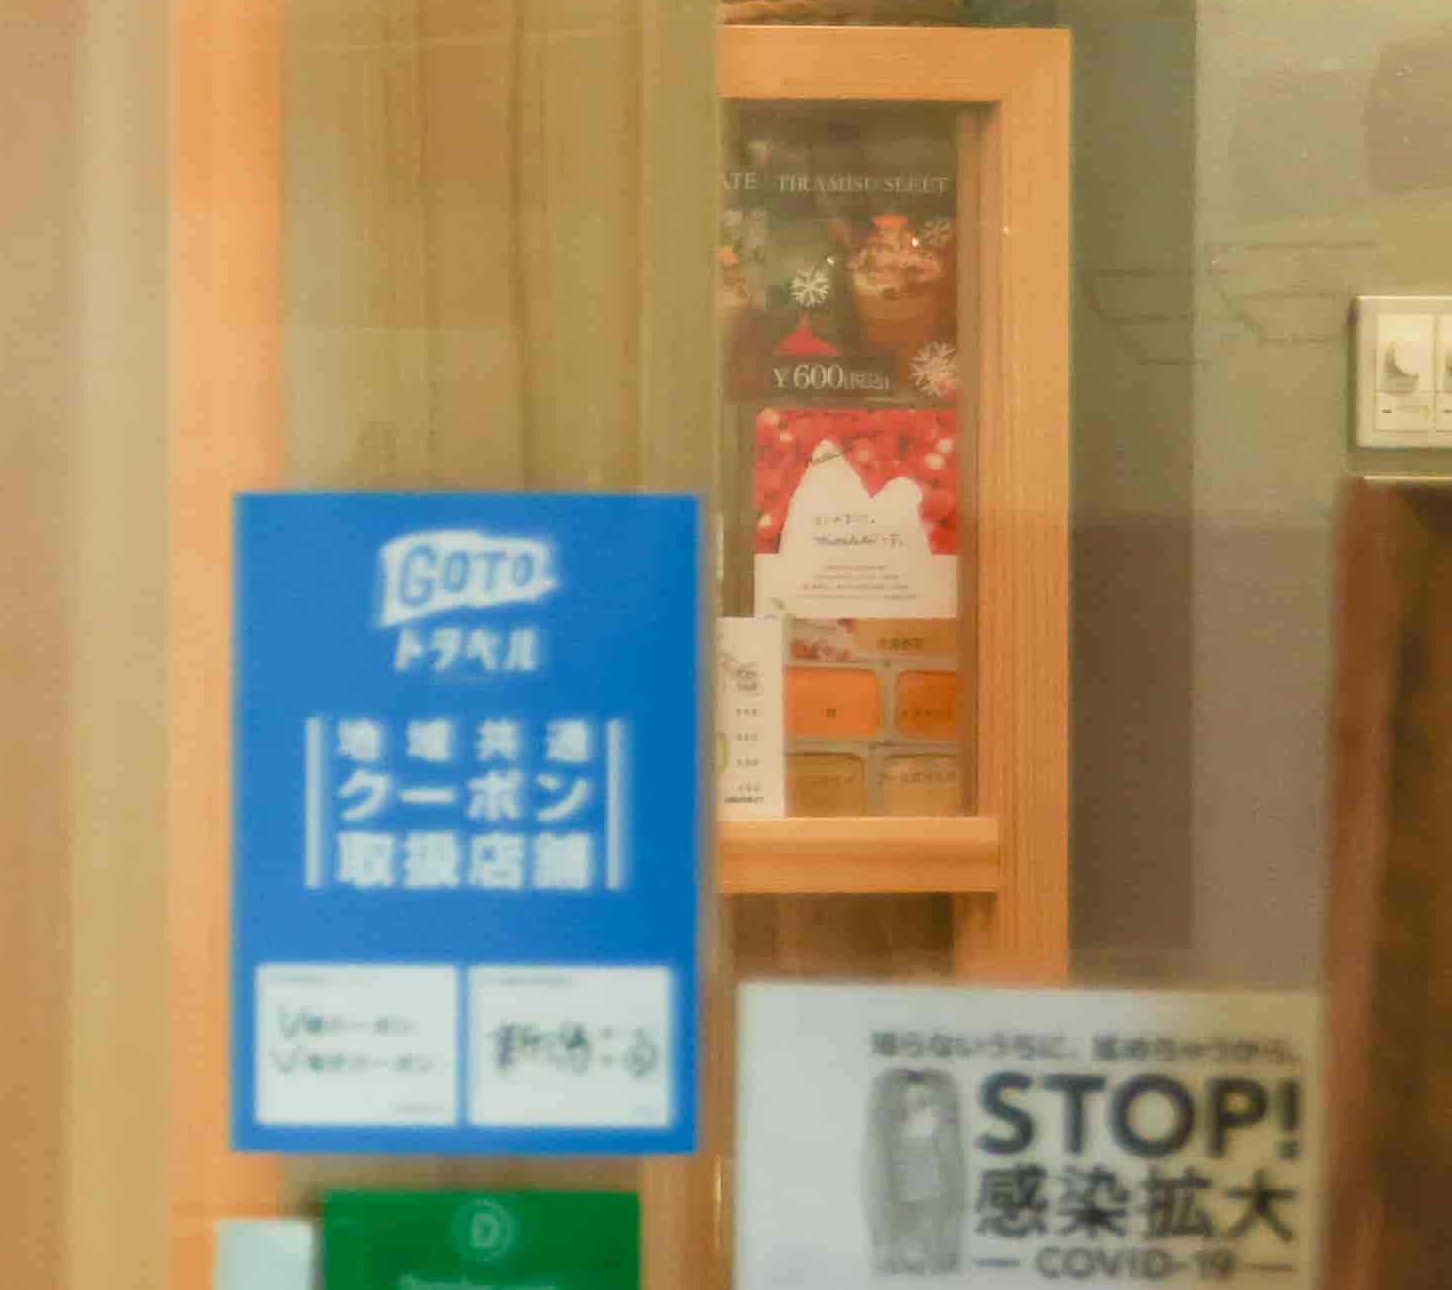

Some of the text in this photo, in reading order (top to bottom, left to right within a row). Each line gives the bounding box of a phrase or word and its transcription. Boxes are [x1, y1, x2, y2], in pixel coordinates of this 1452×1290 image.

[394, 626, 538, 672] トラベル
[339, 767, 594, 823] クーポン
[338, 831, 594, 891] 取扱店舗
[976, 1071, 1301, 1160] STOP!
[975, 1165, 1296, 1241] 感染拡大
[1036, 1250, 1236, 1281] COVID-19
